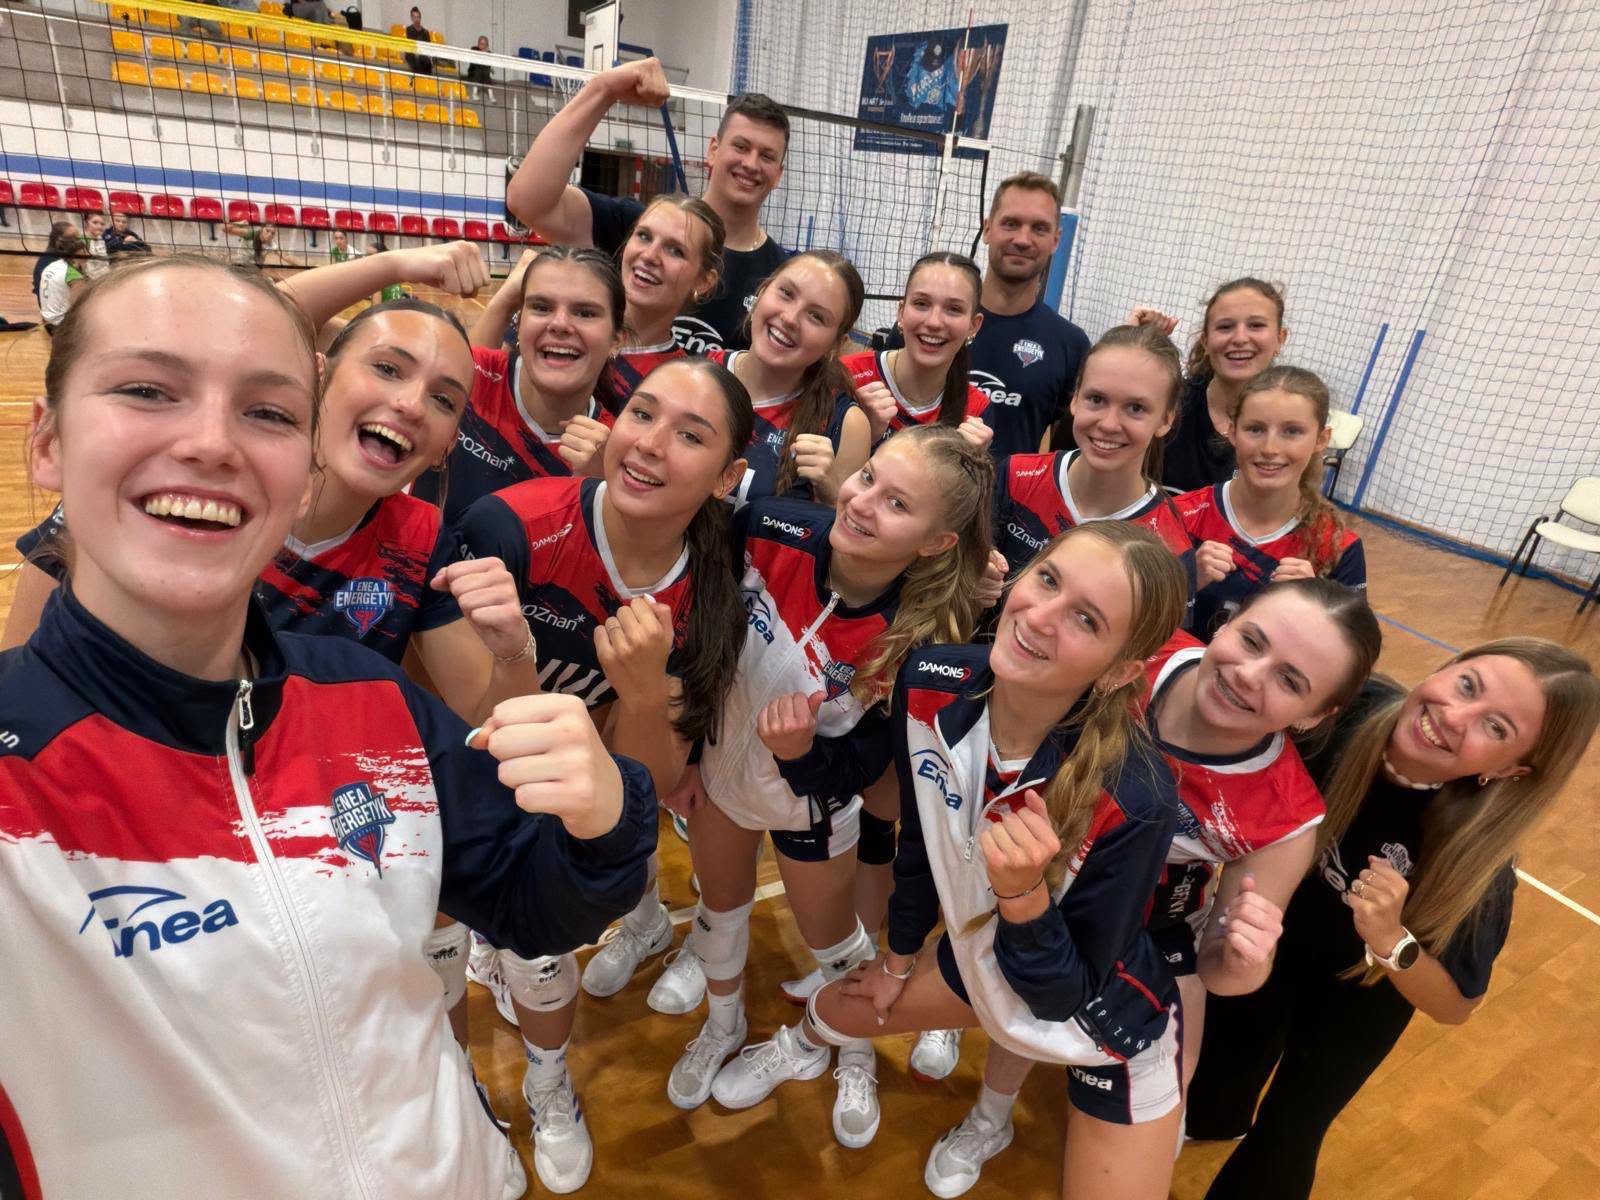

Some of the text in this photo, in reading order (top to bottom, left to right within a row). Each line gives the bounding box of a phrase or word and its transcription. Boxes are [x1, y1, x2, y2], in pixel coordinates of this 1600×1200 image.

[968, 381, 1022, 407] nea
[762, 516, 806, 537] DAMONS
[1006, 522, 1045, 552] OZnan
[336, 591, 395, 608] ENERGETYK
[357, 581, 380, 593] ENEA
[519, 603, 578, 632] OZnan
[918, 661, 965, 678] DAMONS
[917, 757, 964, 811] Ena
[334, 788, 367, 814] ENEA
[1073, 1066, 1113, 1091] nea
